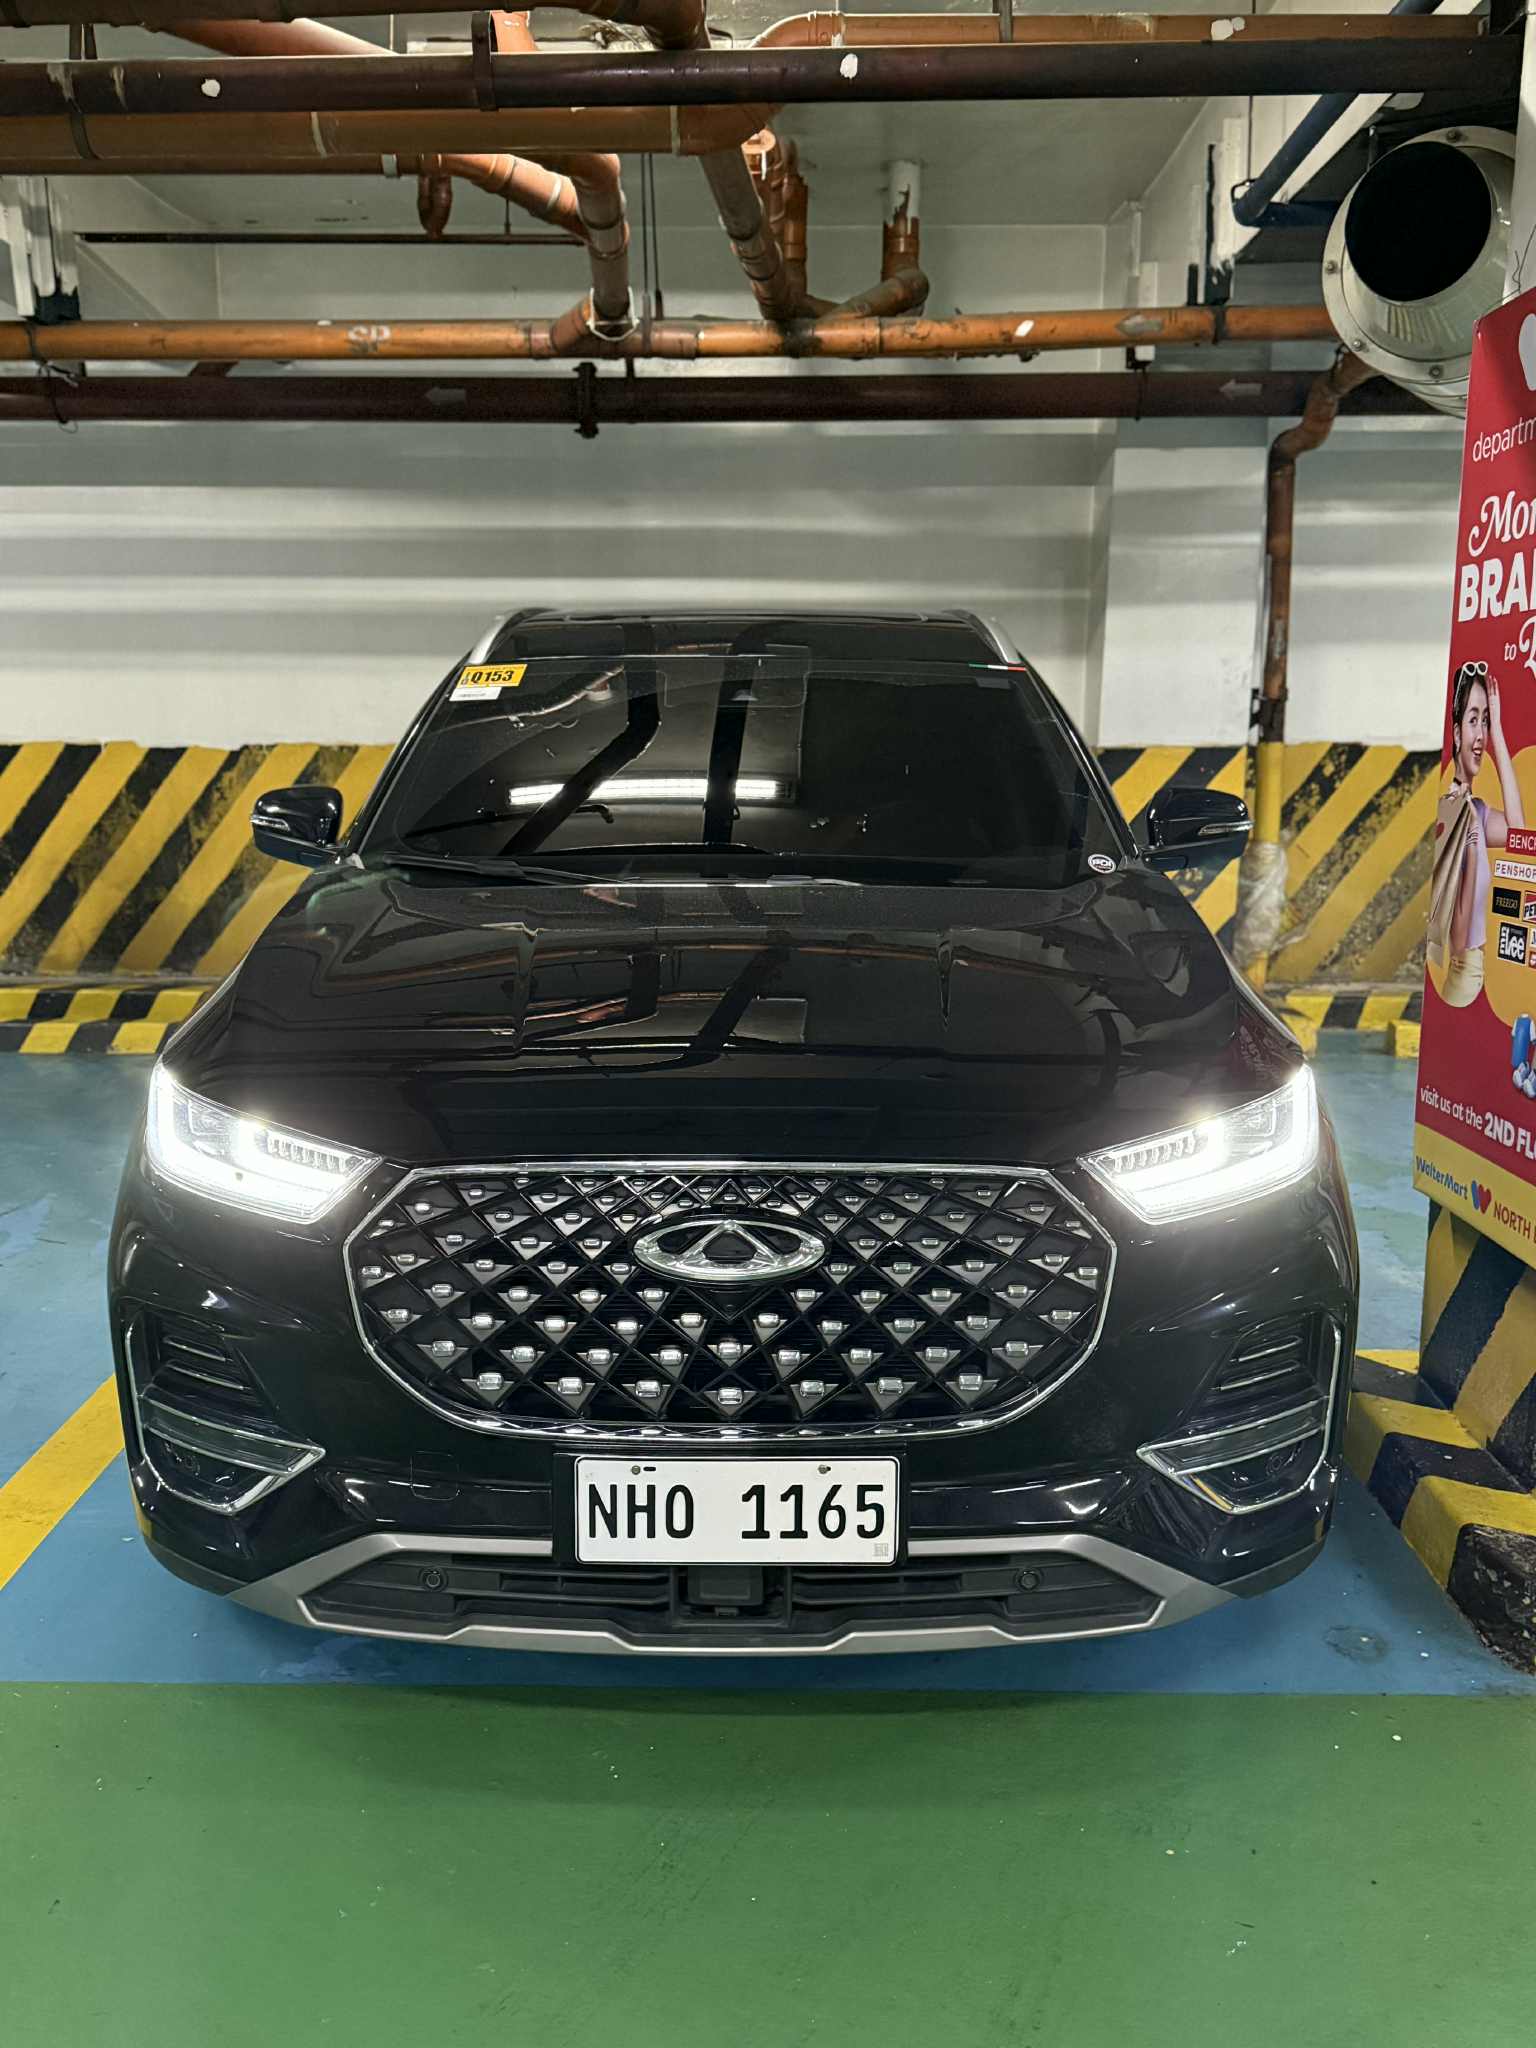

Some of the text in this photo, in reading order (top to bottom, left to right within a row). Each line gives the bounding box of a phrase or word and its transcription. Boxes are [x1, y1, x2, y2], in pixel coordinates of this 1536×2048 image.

[1504, 642, 1517, 661] to
[1420, 1085, 1536, 1160] visit us at the 2ND FL
[1416, 1156, 1468, 1200] WalterMart
[1494, 1201, 1531, 1239] NORTH
[588, 1484, 885, 1539] NHO 1165
